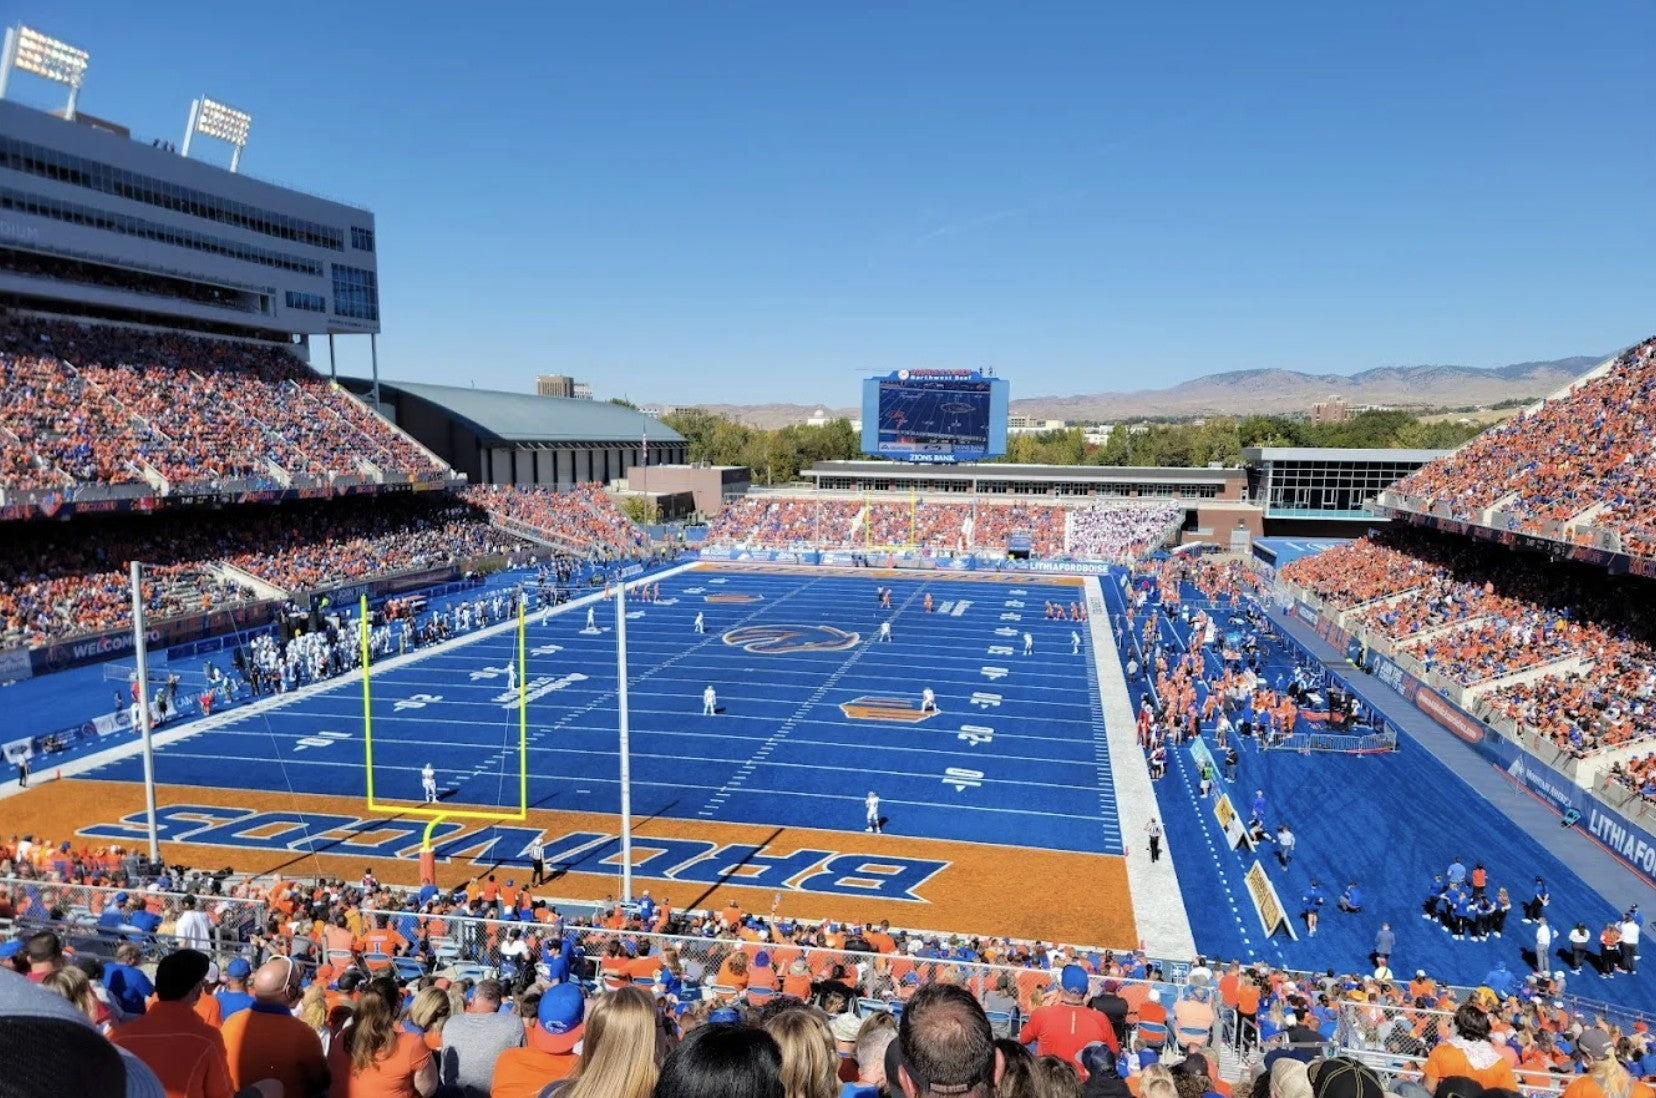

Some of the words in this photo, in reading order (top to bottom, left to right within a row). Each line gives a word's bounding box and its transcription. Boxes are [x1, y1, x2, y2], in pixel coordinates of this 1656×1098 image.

[1030, 562, 1109, 573] LITHIAFORDBOISE
[73, 633, 137, 658] WELCOM
[74, 804, 953, 904] BRONCOS
